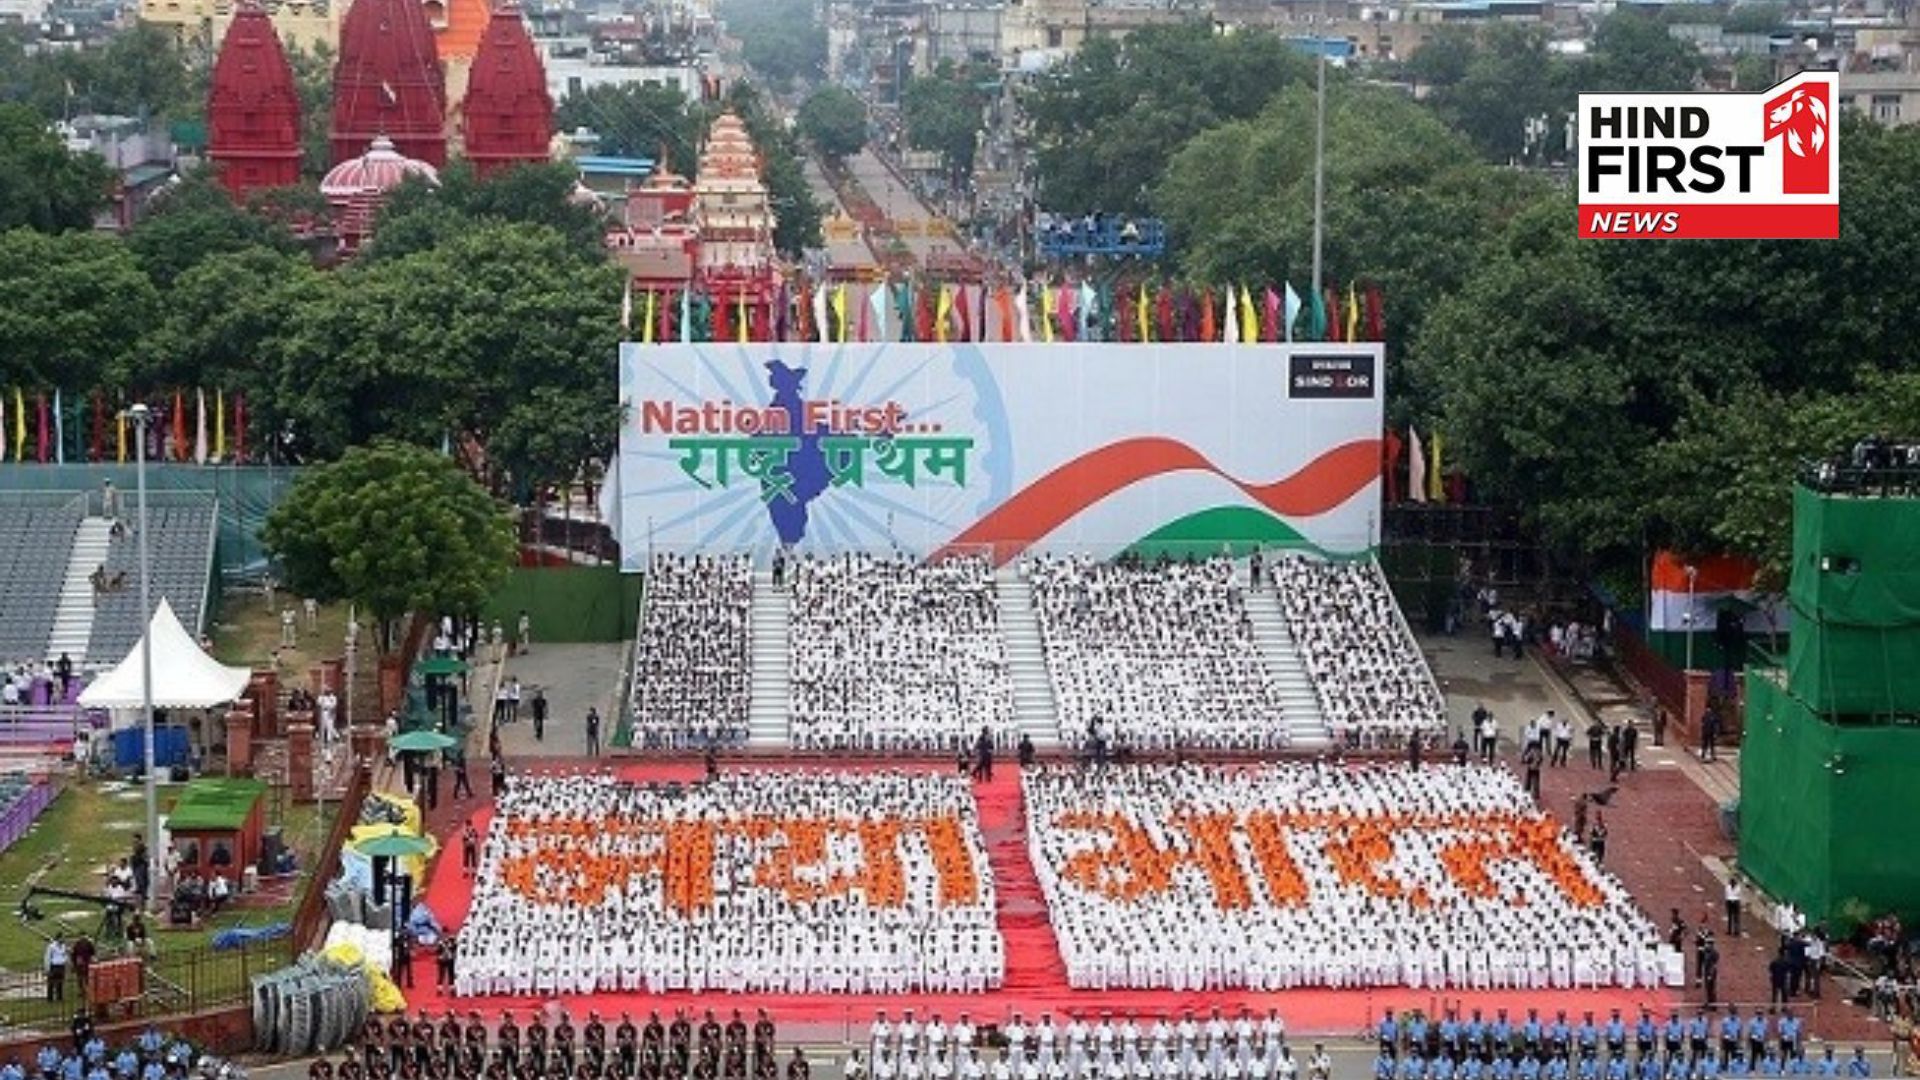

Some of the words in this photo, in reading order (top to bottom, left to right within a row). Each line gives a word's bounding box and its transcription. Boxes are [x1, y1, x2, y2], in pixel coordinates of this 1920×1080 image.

[1294, 375, 1370, 388] SINDOR
[642, 401, 790, 434] Nation
[804, 401, 943, 434] First...
[669, 437, 799, 504] राष्ट्र
[820, 437, 974, 488] प्रथम
[1054, 810, 1606, 909] भारत
